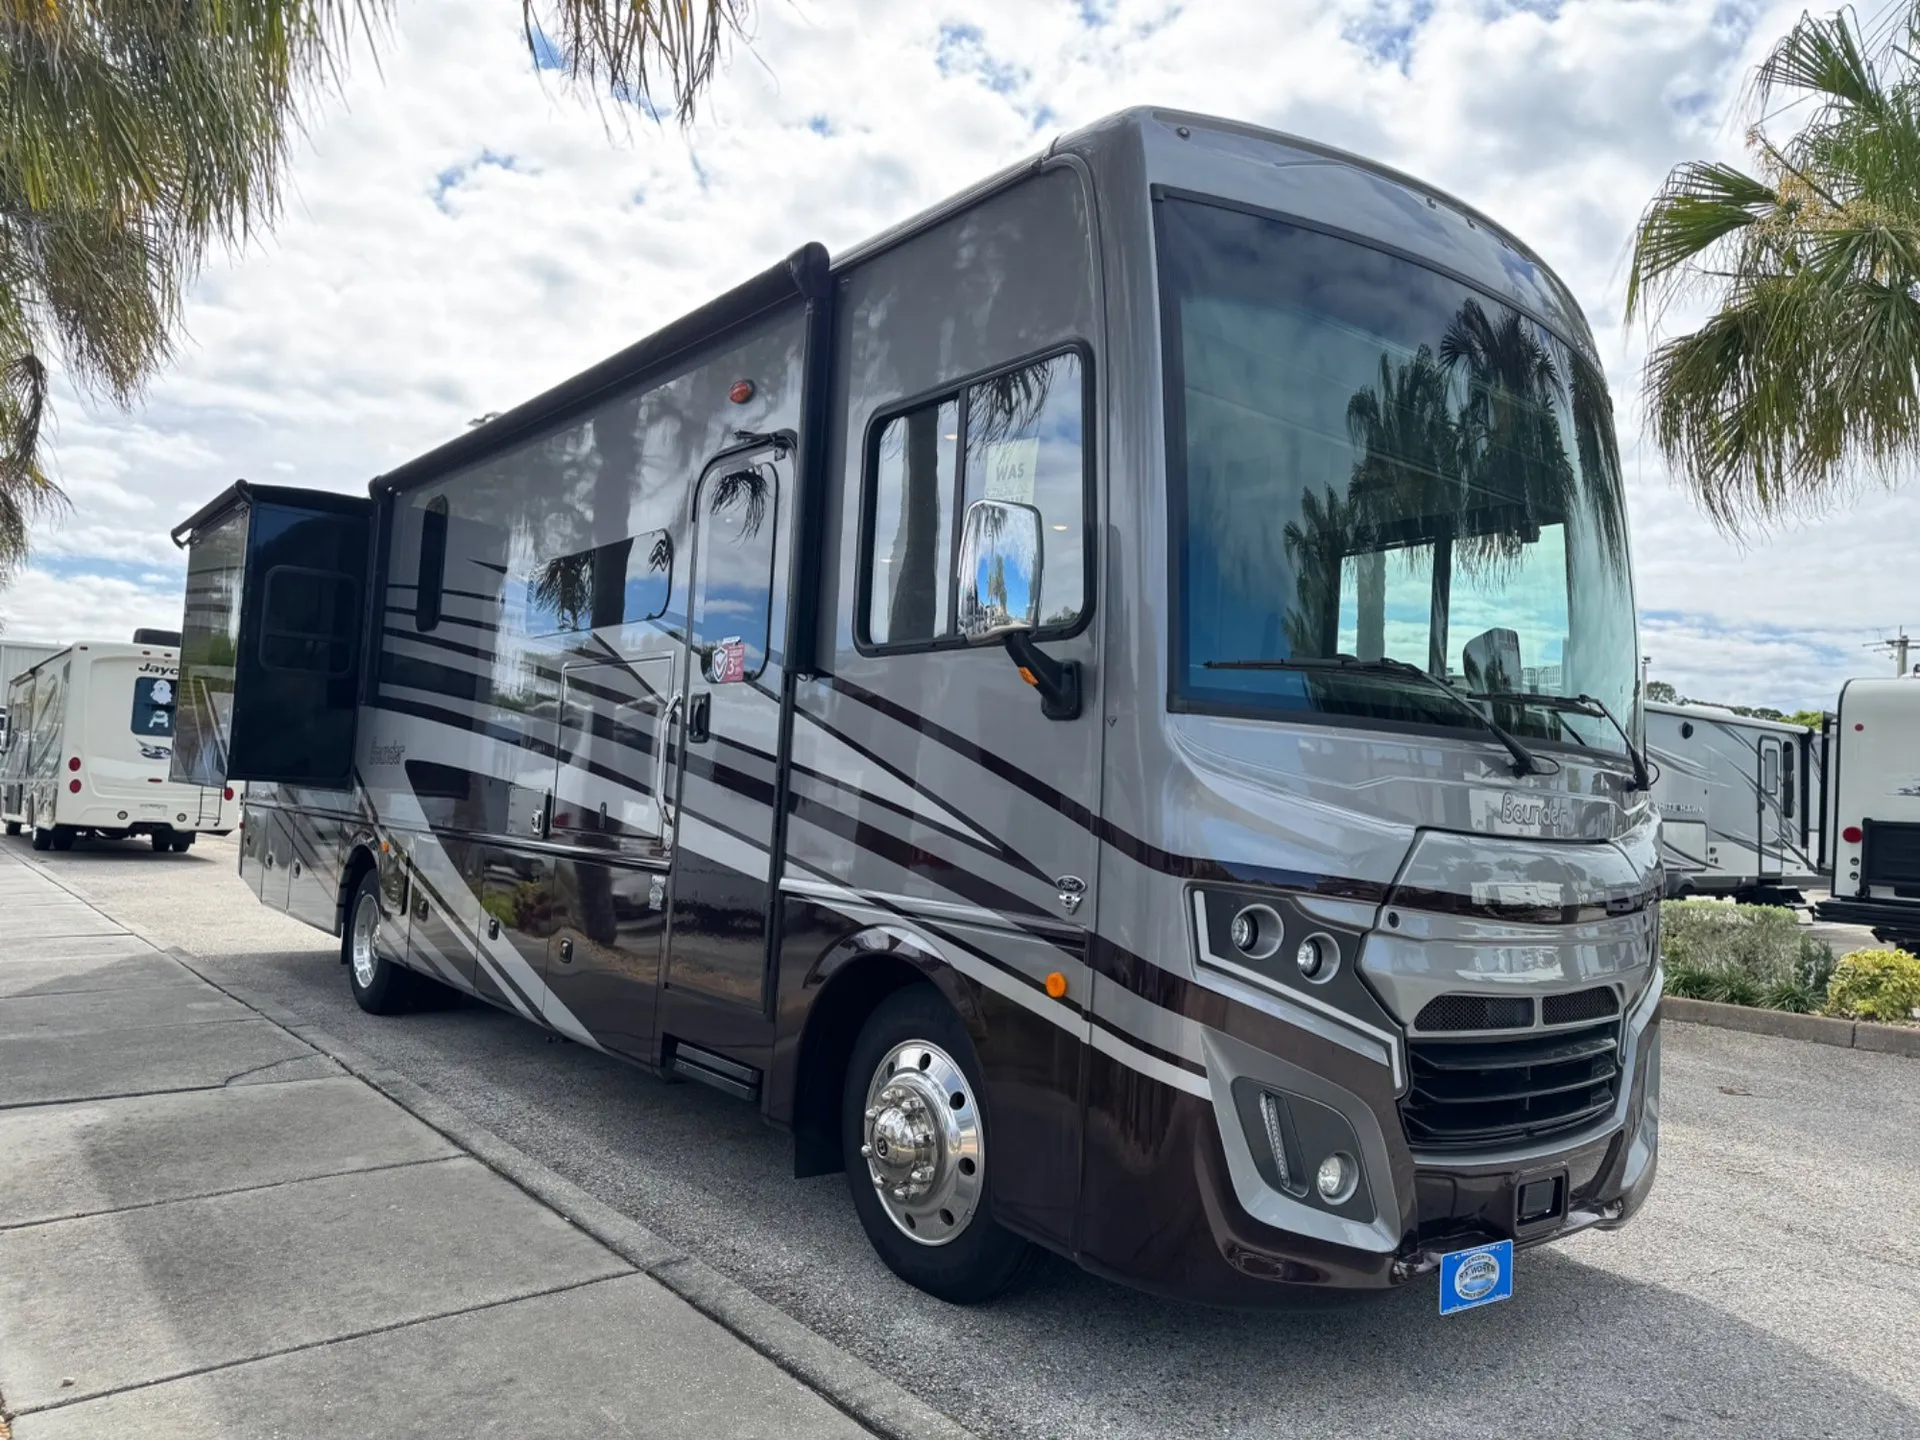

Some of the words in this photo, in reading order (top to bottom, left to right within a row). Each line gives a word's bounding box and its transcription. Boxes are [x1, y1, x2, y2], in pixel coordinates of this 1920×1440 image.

[996, 462, 1024, 481] WAS
[138, 662, 179, 676] Jayc
[728, 658, 735, 674] 3
[1500, 791, 1568, 828] Bounder
